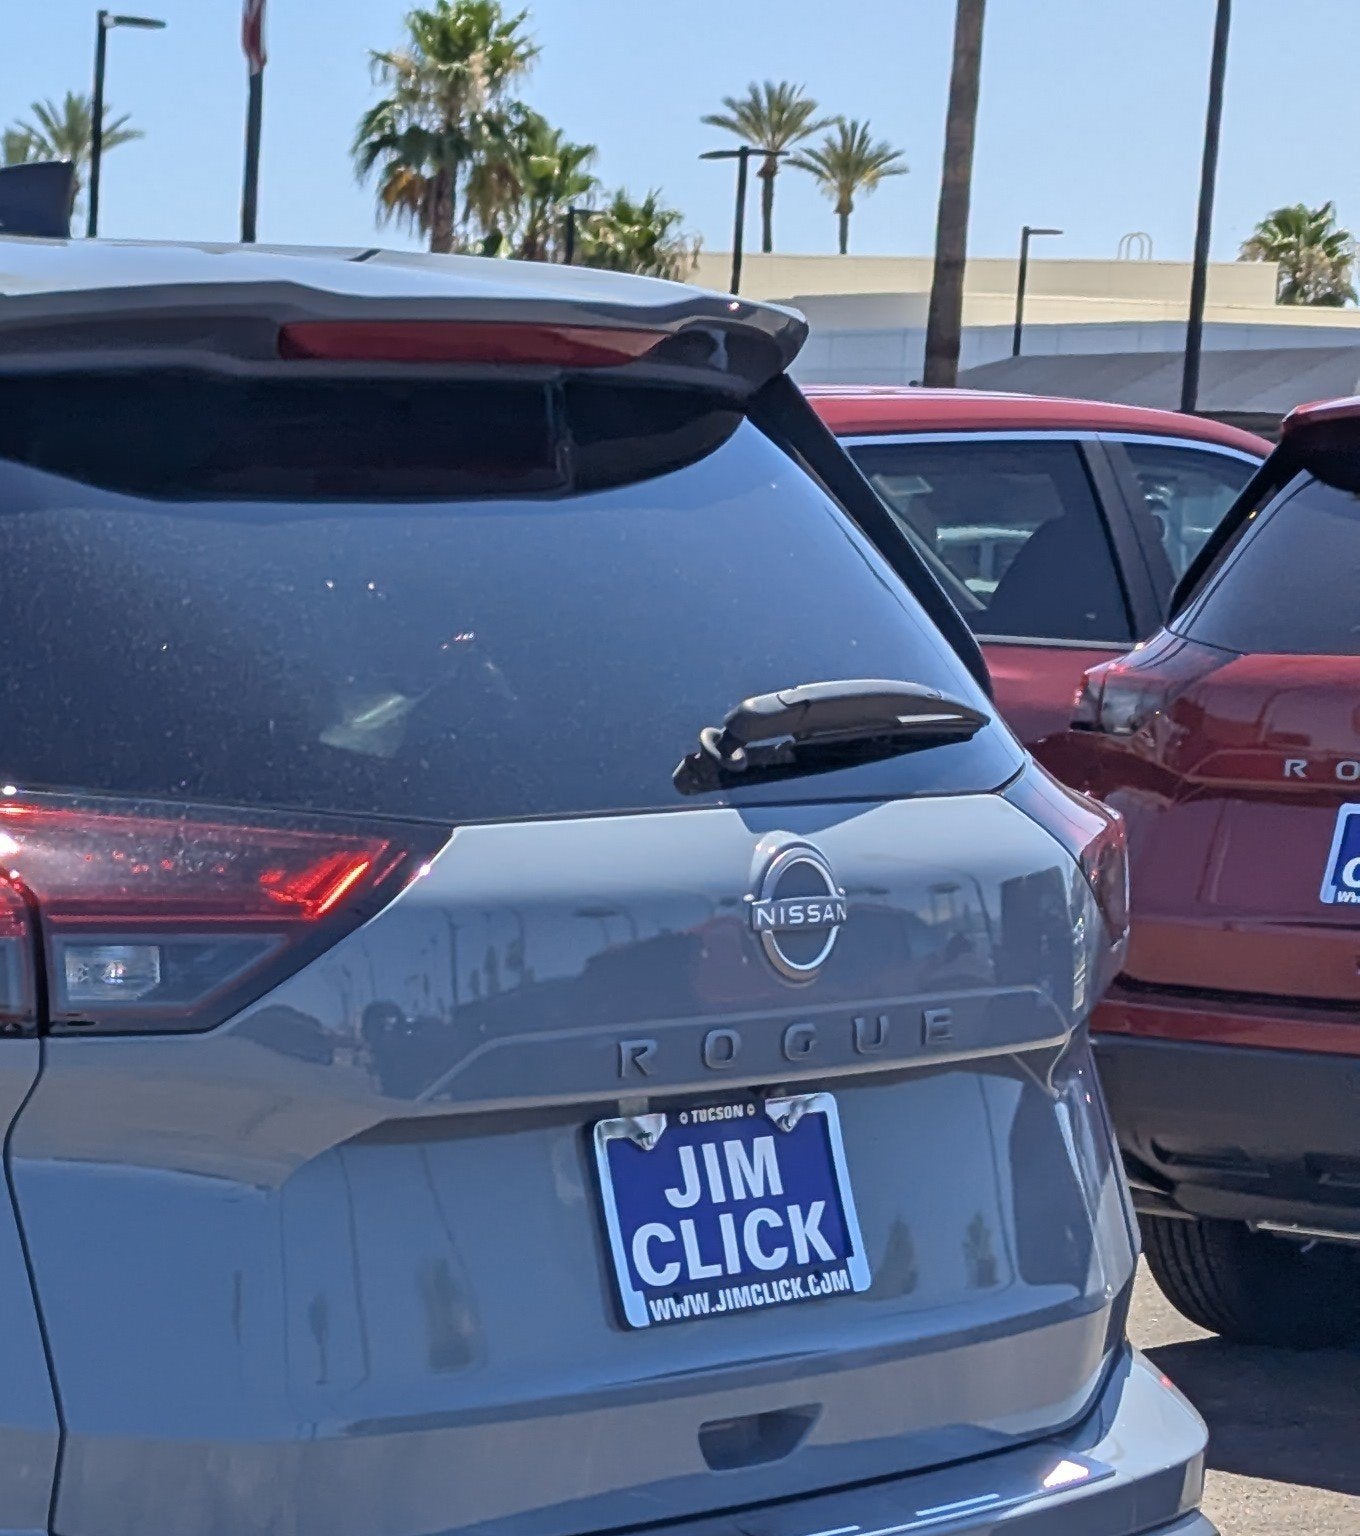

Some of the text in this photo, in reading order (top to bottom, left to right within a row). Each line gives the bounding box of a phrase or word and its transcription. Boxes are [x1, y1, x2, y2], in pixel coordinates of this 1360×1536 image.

[757, 903, 847, 926] NISSAN
[618, 1008, 954, 1077] ROGUE
[691, 1103, 744, 1123] TUCSON
[664, 1135, 784, 1208] JIM
[632, 1200, 837, 1287] CLICK
